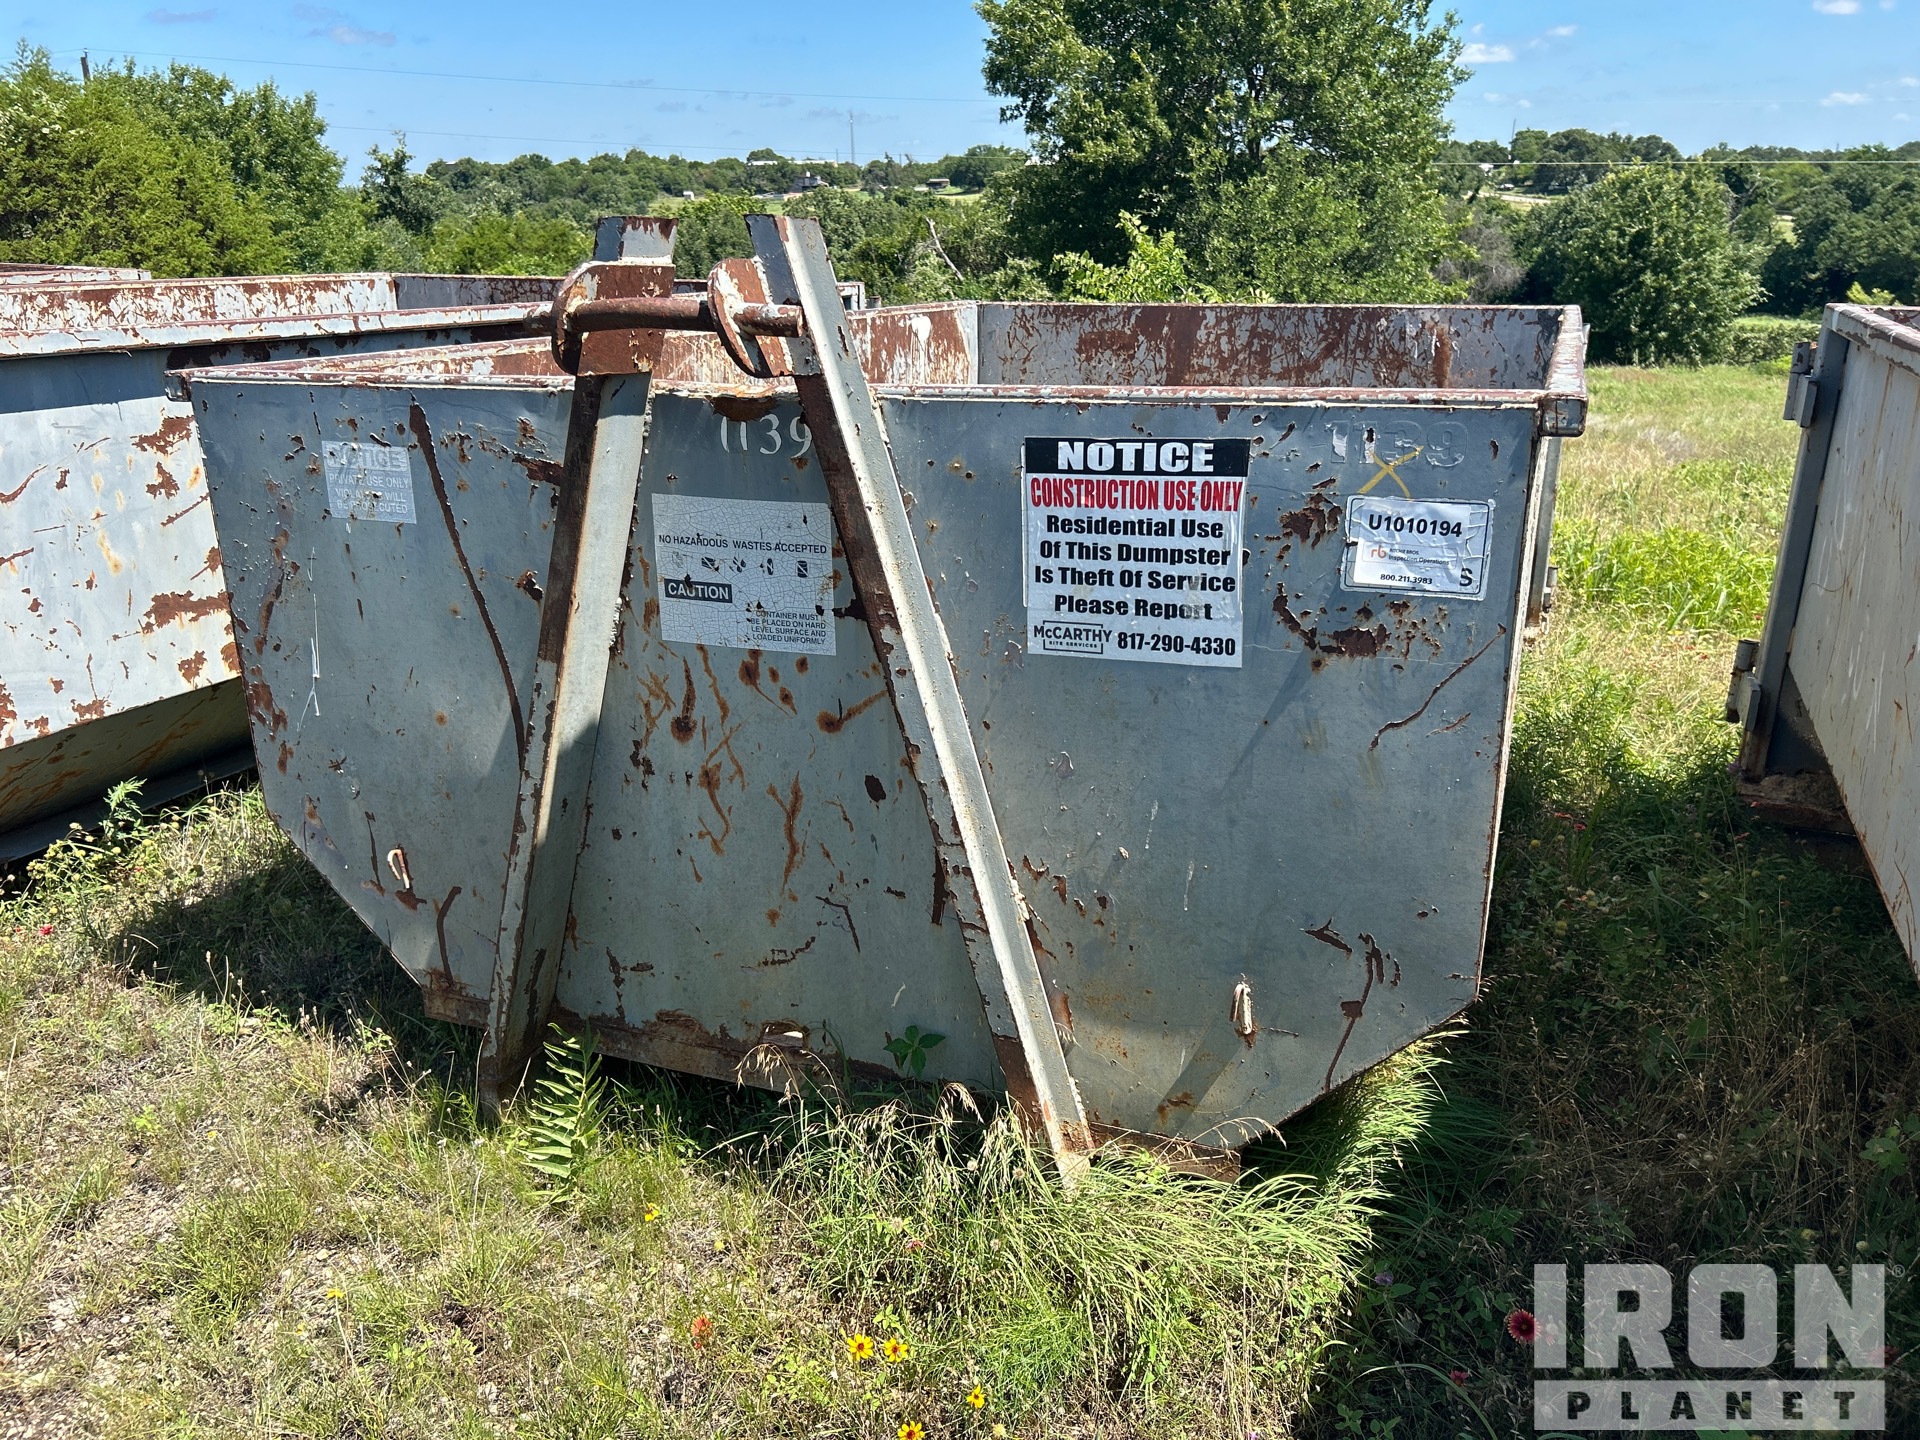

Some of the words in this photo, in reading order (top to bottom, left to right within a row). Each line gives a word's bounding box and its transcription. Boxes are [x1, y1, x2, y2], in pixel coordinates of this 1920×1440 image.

[1057, 441, 1214, 473] NOTICE
[366, 476, 384, 487] USE
[386, 477, 409, 488] ONLY
[385, 492, 406, 503] WILL
[1031, 477, 1159, 510] CONSTRUCTION
[1163, 480, 1196, 511] USE
[1200, 480, 1243, 512] ONLY
[1046, 515, 1176, 537] Residential
[1181, 519, 1223, 538] Use
[1368, 513, 1463, 537] U1010194
[658, 535, 671, 544] NO
[673, 536, 728, 548] HAZARDOUS
[733, 540, 772, 551] WASTES
[774, 543, 827, 554] ACCEPTED
[1040, 540, 1061, 559] Of
[1065, 541, 1111, 561] This
[1118, 543, 1231, 566] Dumpster
[1035, 566, 1054, 584] Is
[1058, 567, 1114, 587] Theft
[1119, 570, 1142, 588] Of
[1147, 570, 1236, 592] Service
[1380, 573, 1433, 584] 800.211.3983
[1459, 567, 1473, 586] S
[668, 581, 730, 600] CAUTION
[756, 610, 797, 620] CONTAINER
[1054, 595, 1129, 615] Please
[1134, 599, 1213, 620] Report
[762, 619, 791, 627] PLACED
[775, 628, 809, 636] SURFACE
[753, 634, 783, 642] LOADED
[784, 636, 826, 645] UNIFORMLY
[1033, 625, 1113, 643] McCARTHY
[1117, 632, 1236, 656] 817-290-4330
